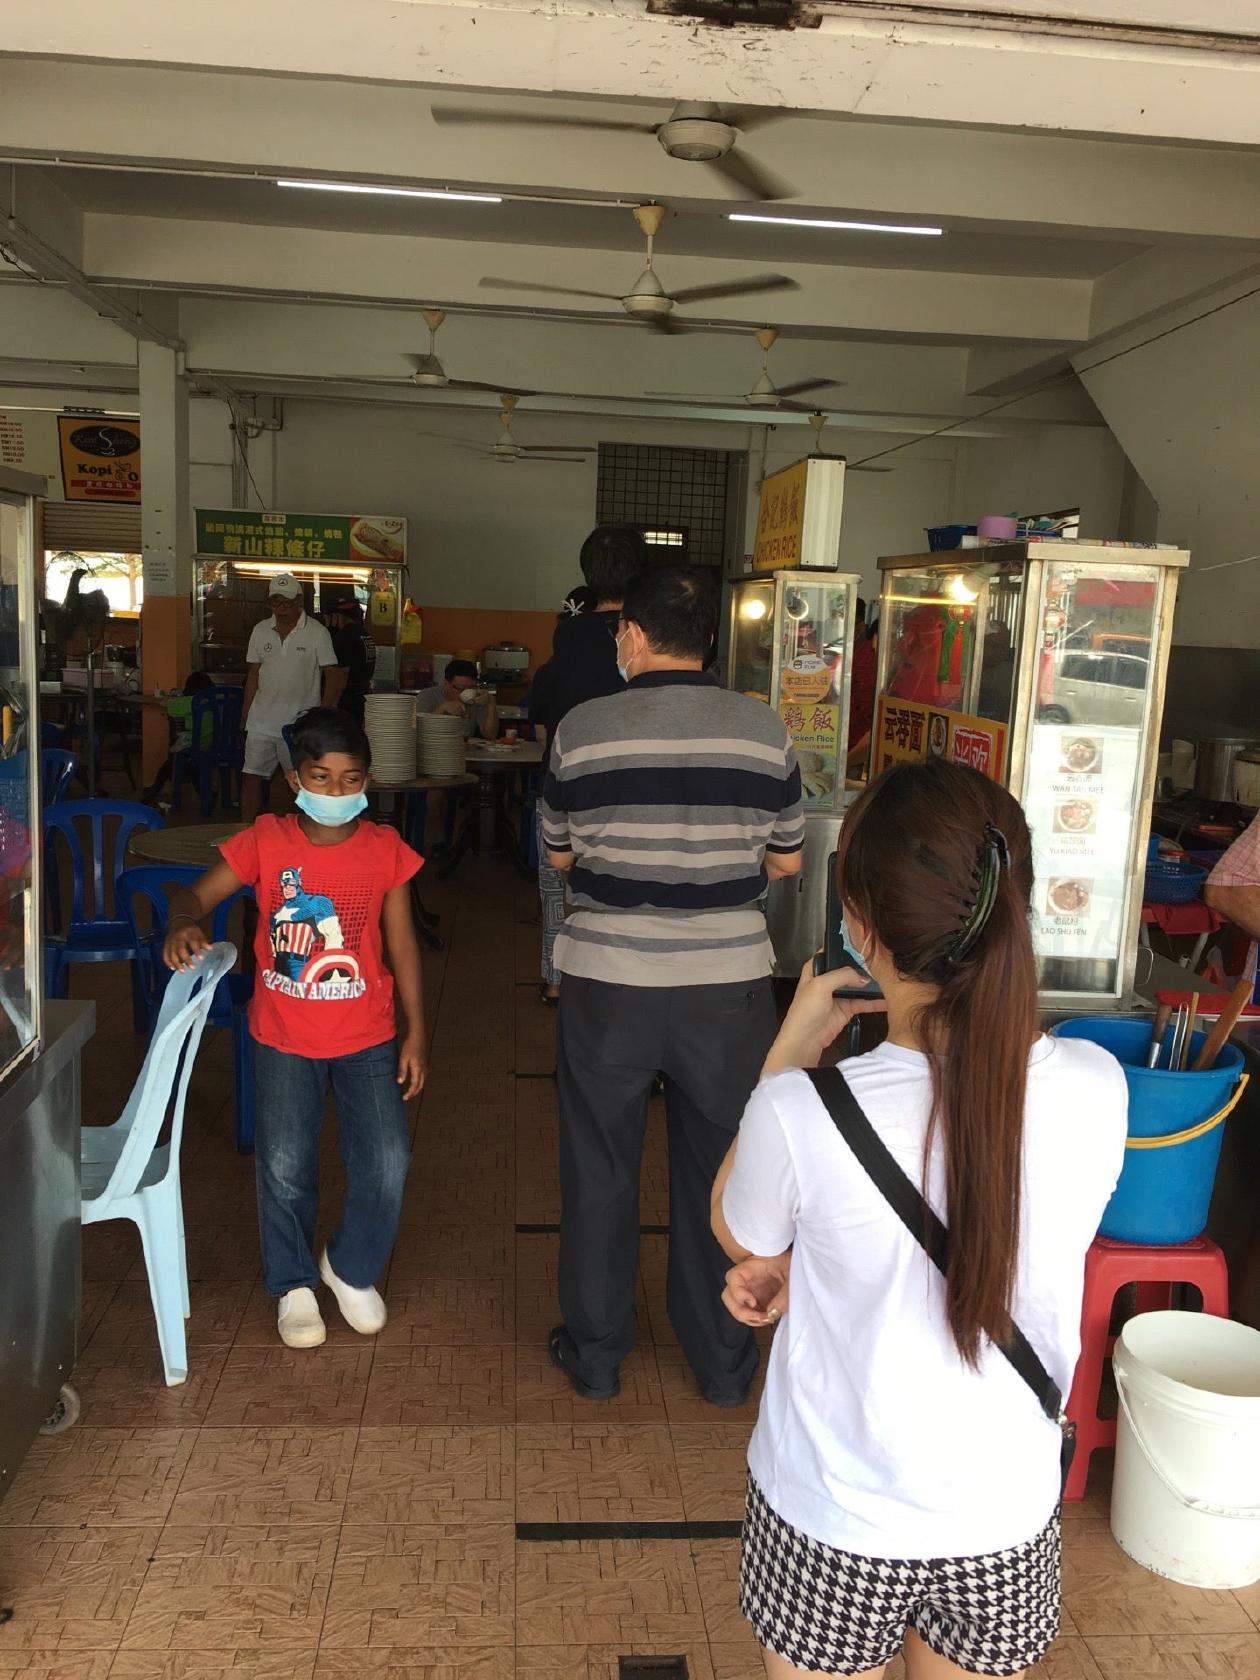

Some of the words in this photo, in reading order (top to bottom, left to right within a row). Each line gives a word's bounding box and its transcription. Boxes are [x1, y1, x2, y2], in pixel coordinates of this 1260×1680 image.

[77, 464, 112, 476] Kopi
[783, 534, 797, 559] RICE
[262, 969, 307, 999] CAPTAIN
[308, 978, 366, 1000] AMERICA
